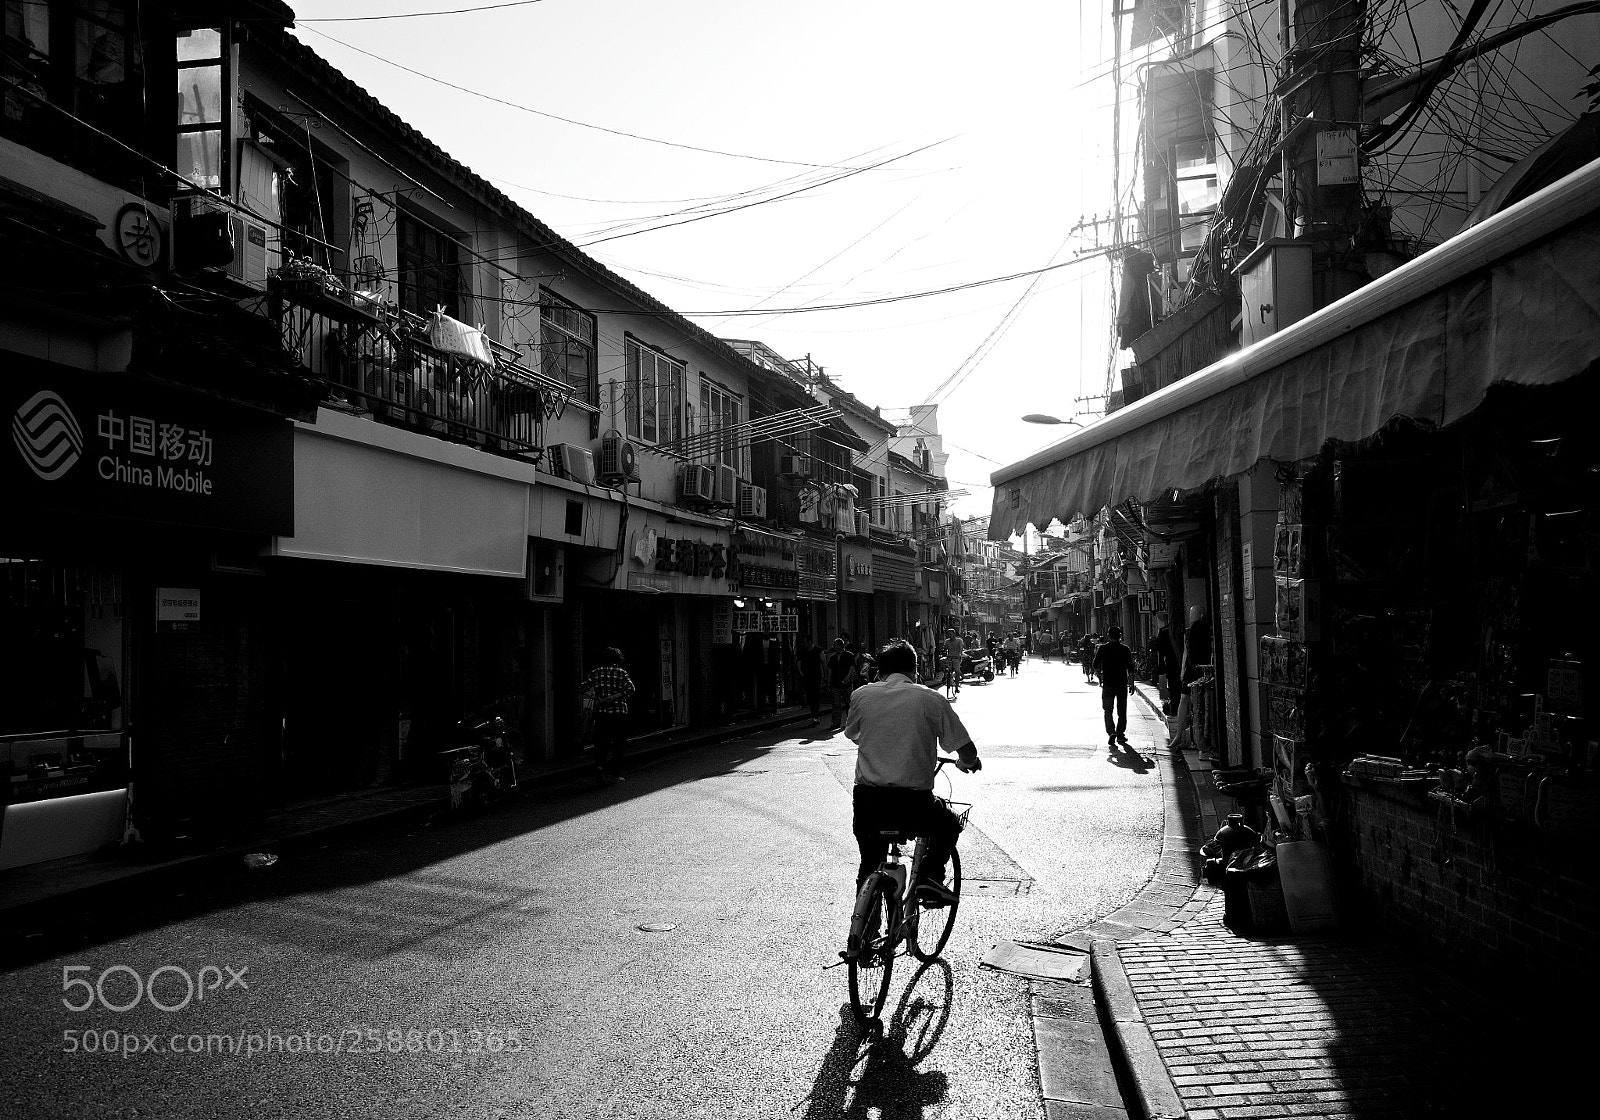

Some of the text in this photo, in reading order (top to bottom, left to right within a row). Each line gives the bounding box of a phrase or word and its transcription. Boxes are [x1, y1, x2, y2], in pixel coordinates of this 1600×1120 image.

[124, 216, 155, 260] 老
[98, 409, 213, 466] 中国移动
[98, 456, 213, 495] China Mobile
